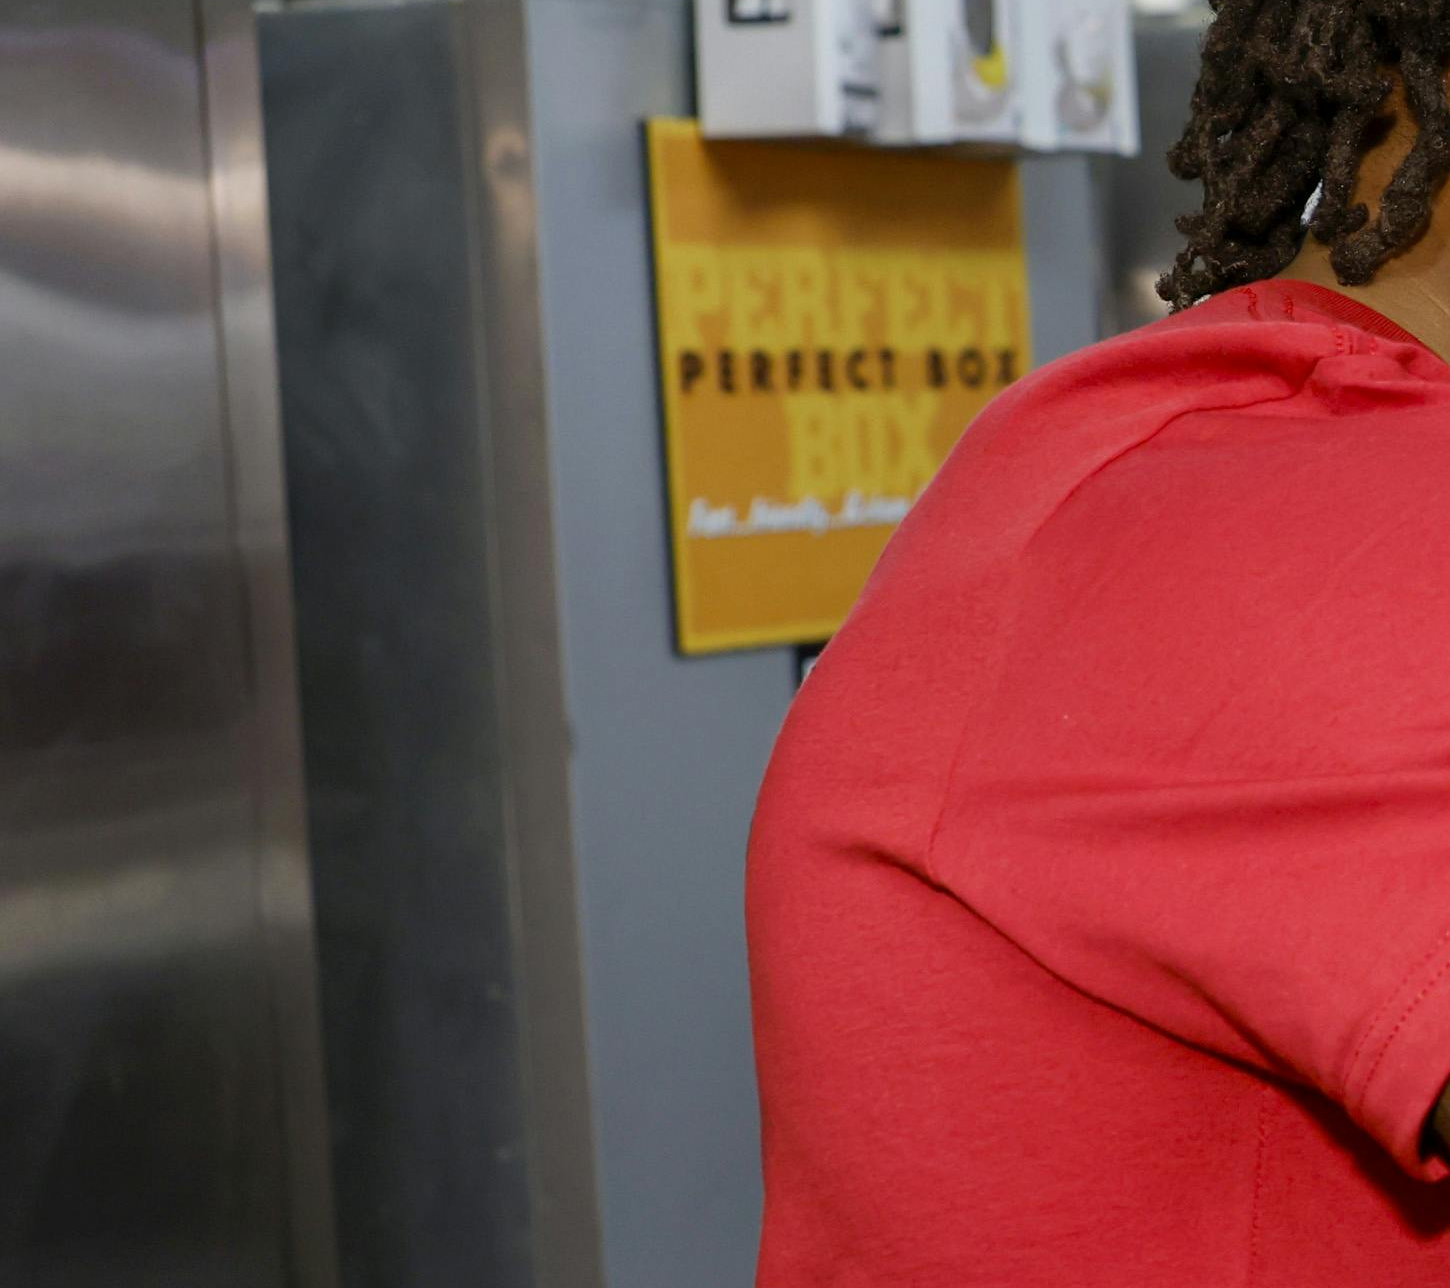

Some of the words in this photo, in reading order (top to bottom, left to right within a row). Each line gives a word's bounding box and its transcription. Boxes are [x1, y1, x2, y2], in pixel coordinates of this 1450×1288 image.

[672, 247, 1020, 347] PERFECT
[680, 347, 897, 395] PERFECT
[926, 346, 1018, 390] BOX
[787, 395, 938, 499] BOX
